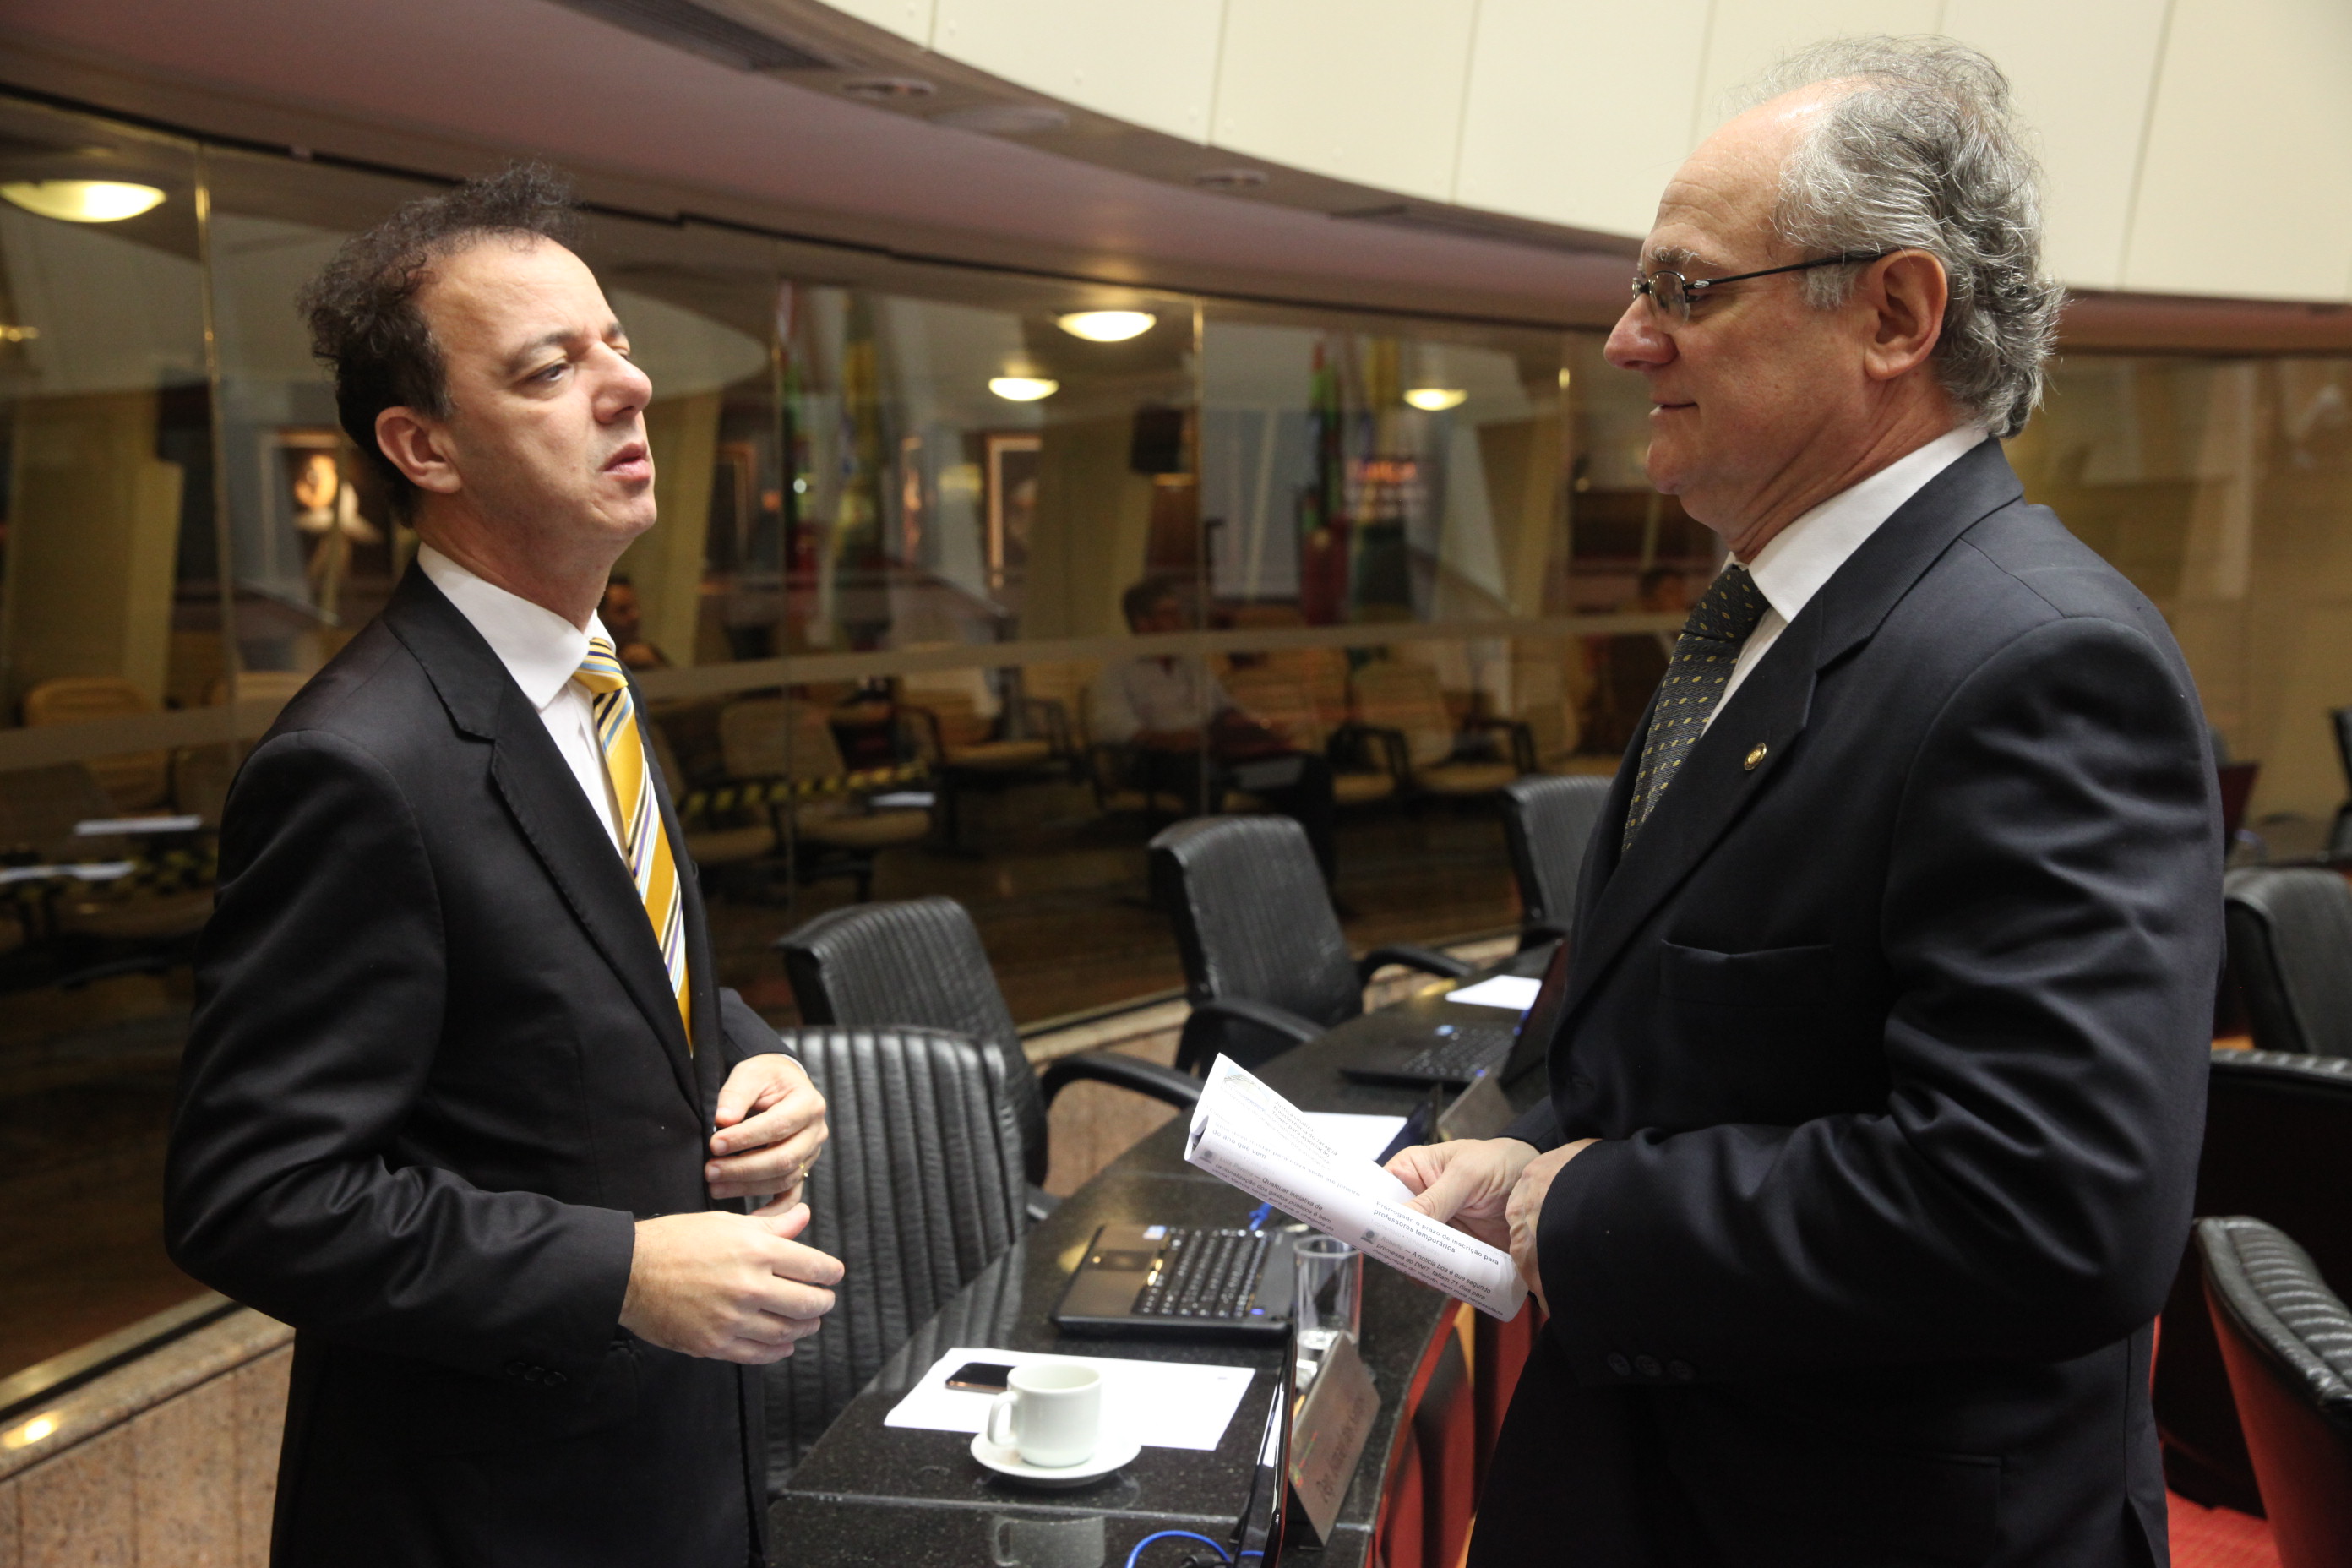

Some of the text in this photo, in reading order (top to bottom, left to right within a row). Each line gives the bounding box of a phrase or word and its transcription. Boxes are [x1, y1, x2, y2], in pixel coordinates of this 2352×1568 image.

[1288, 1124, 1301, 1136] para
[1300, 1135, 1330, 1157] associação
[1293, 1115, 1314, 1132] sinaliza
[1222, 1135, 1236, 1144] ano
[1237, 1141, 1250, 1152] que
[1252, 1149, 1266, 1159] vem
[1215, 1163, 1256, 1189] racionalização
[1268, 1190, 1288, 1202] gastos
[1318, 1213, 1331, 1223] bem
[1261, 1177, 1289, 1194] Qualquer
[1288, 1191, 1315, 1206] iniciativa
[1272, 1151, 1288, 1161] para
[1336, 1182, 1360, 1196] janeiro
[1267, 1197, 1282, 1206] para
[1373, 1209, 1456, 1253] professores temporários
[1376, 1200, 1414, 1223] Prorrogado
[1421, 1224, 1440, 1236] prazo
[1451, 1239, 1483, 1257] inscrição
[1483, 1255, 1499, 1266] para
[1375, 1244, 1405, 1260] promessa
[1431, 1270, 1450, 1282] faltam
[1458, 1284, 1472, 1293] dias
[1471, 1291, 1485, 1300] para
[1380, 1236, 1403, 1250] Roberto
[1436, 1263, 1449, 1273] boa
[1453, 1272, 1466, 1282] que
[1465, 1278, 1491, 1294] segundo
